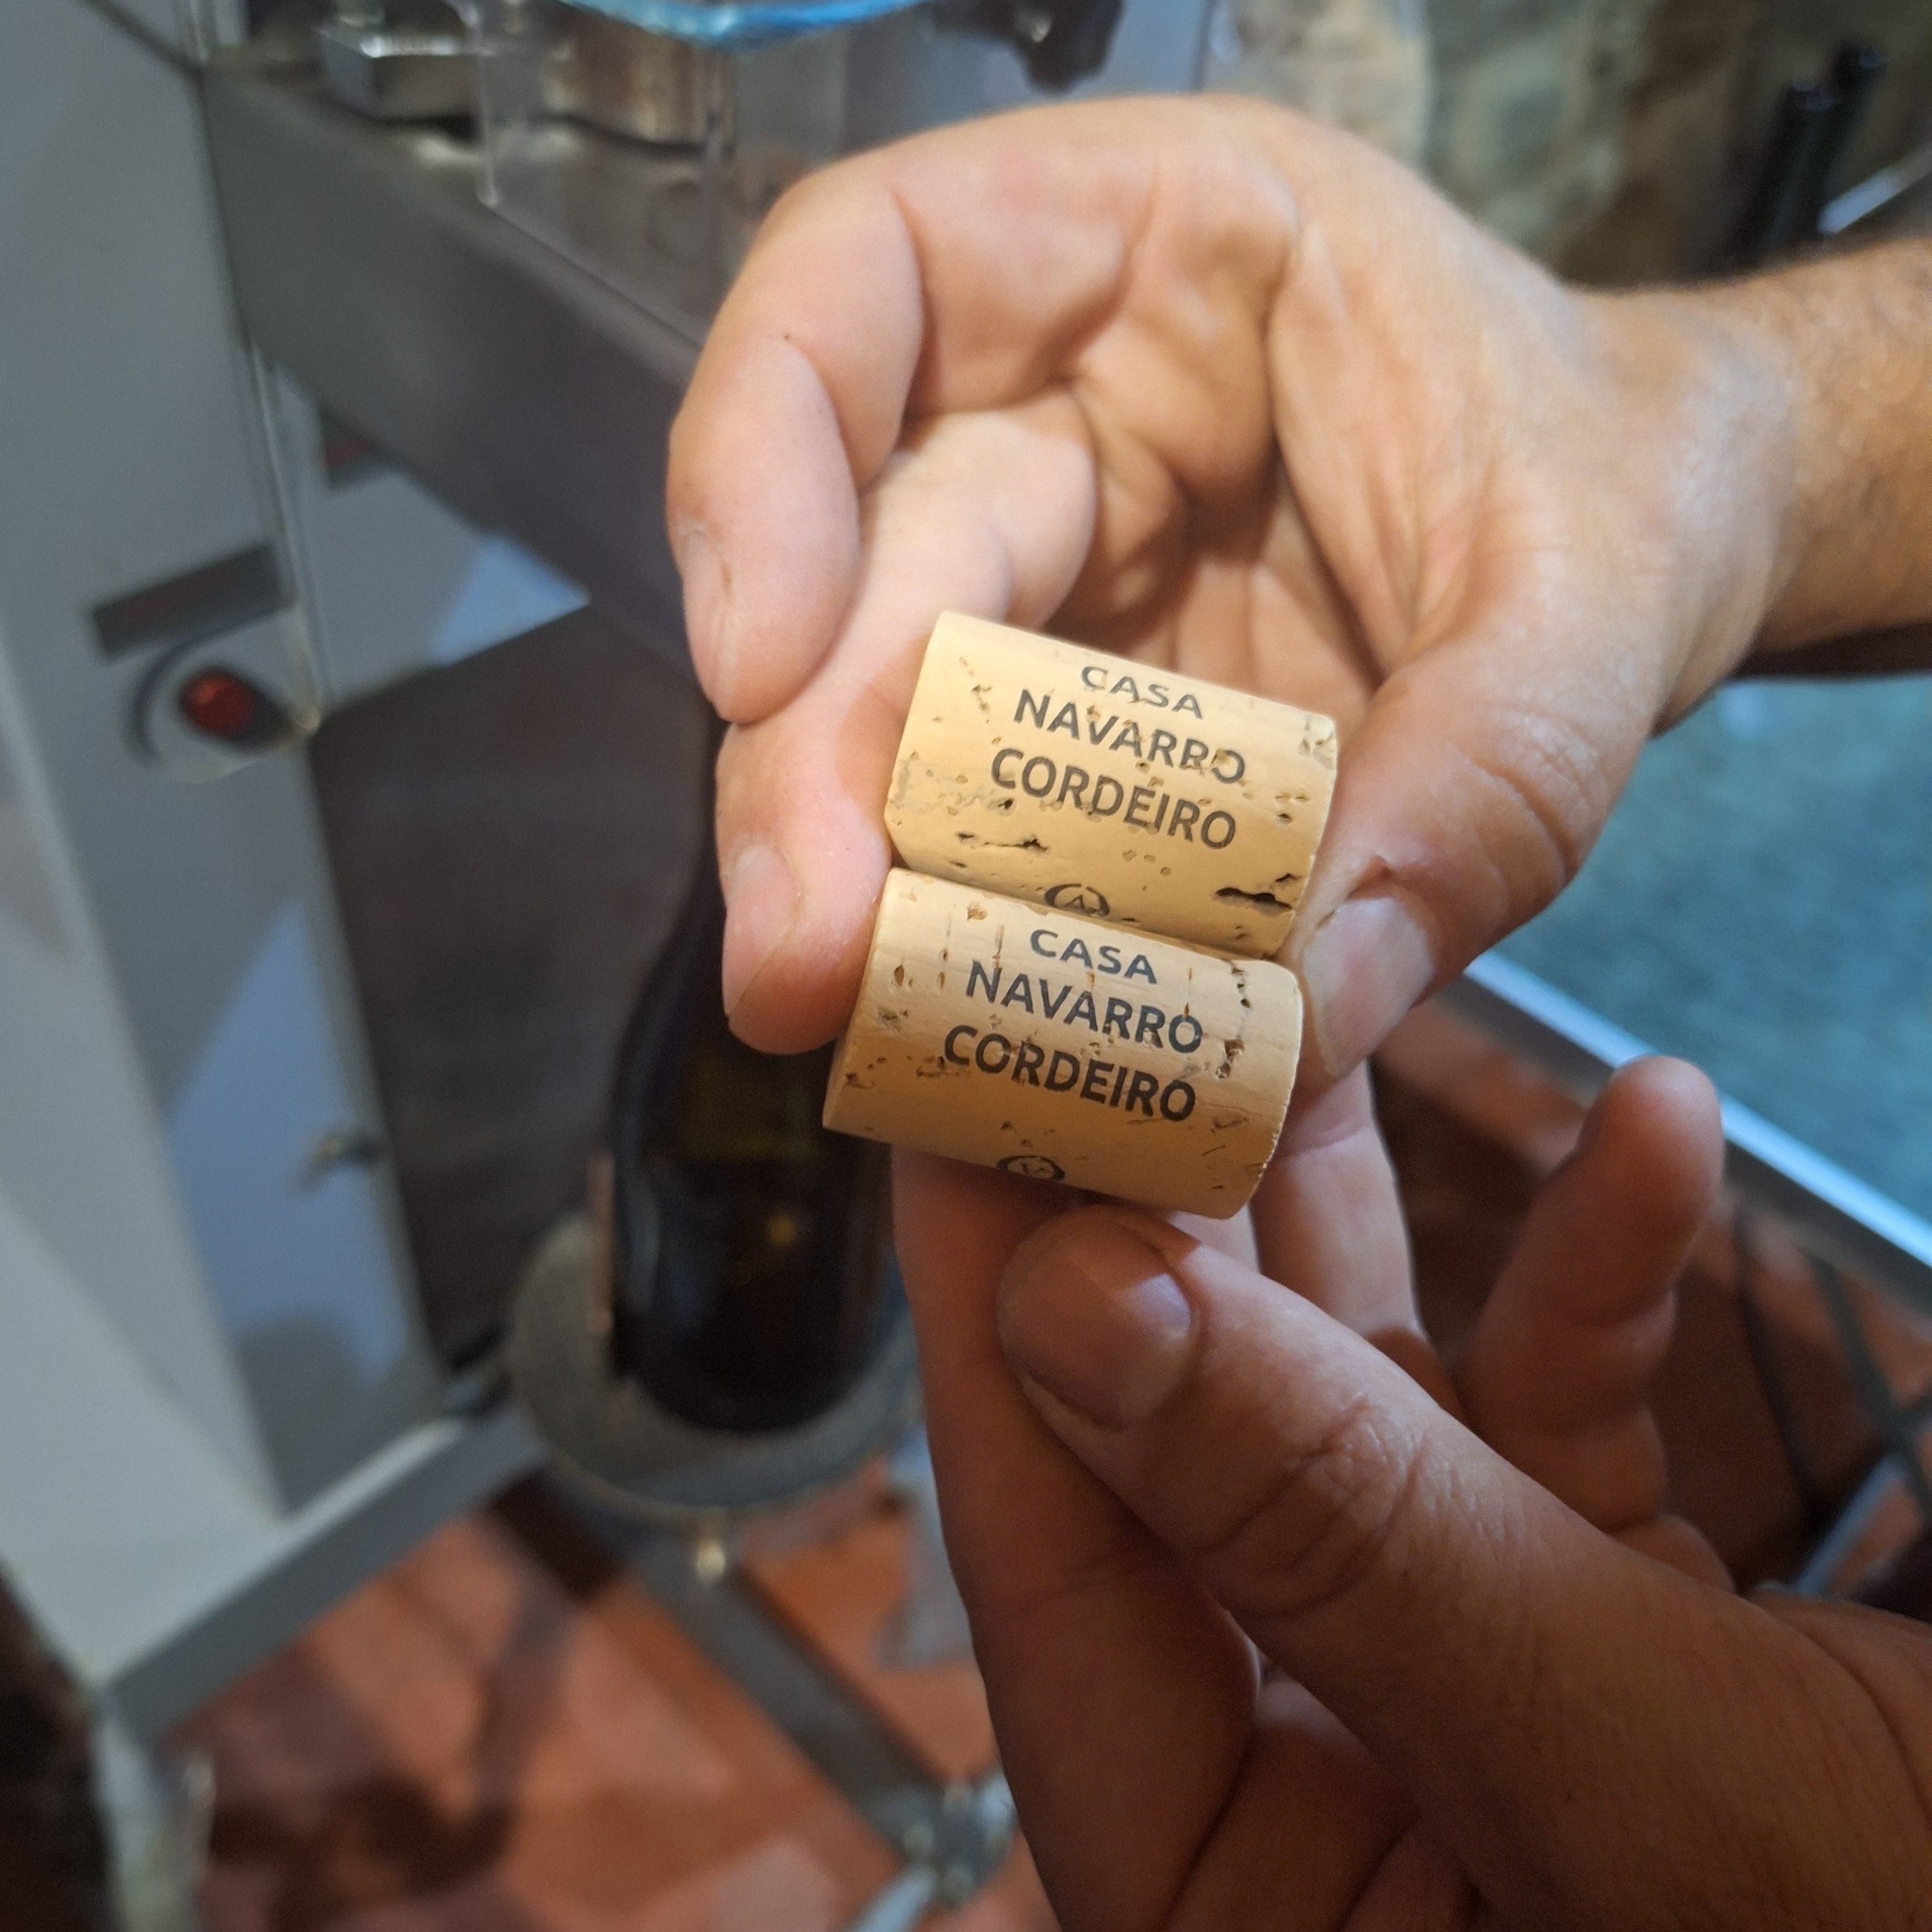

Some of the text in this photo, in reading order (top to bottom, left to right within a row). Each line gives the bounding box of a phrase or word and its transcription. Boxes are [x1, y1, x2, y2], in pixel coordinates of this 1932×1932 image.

[1013, 689, 1246, 784] NAVARRO
[1081, 665, 1203, 720] CASA
[991, 748, 1236, 850] CORDEIRO
[1030, 929, 1157, 985] CASA
[965, 960, 1203, 1053] NAVARRO
[944, 1025, 1196, 1122] CORDEIRO
